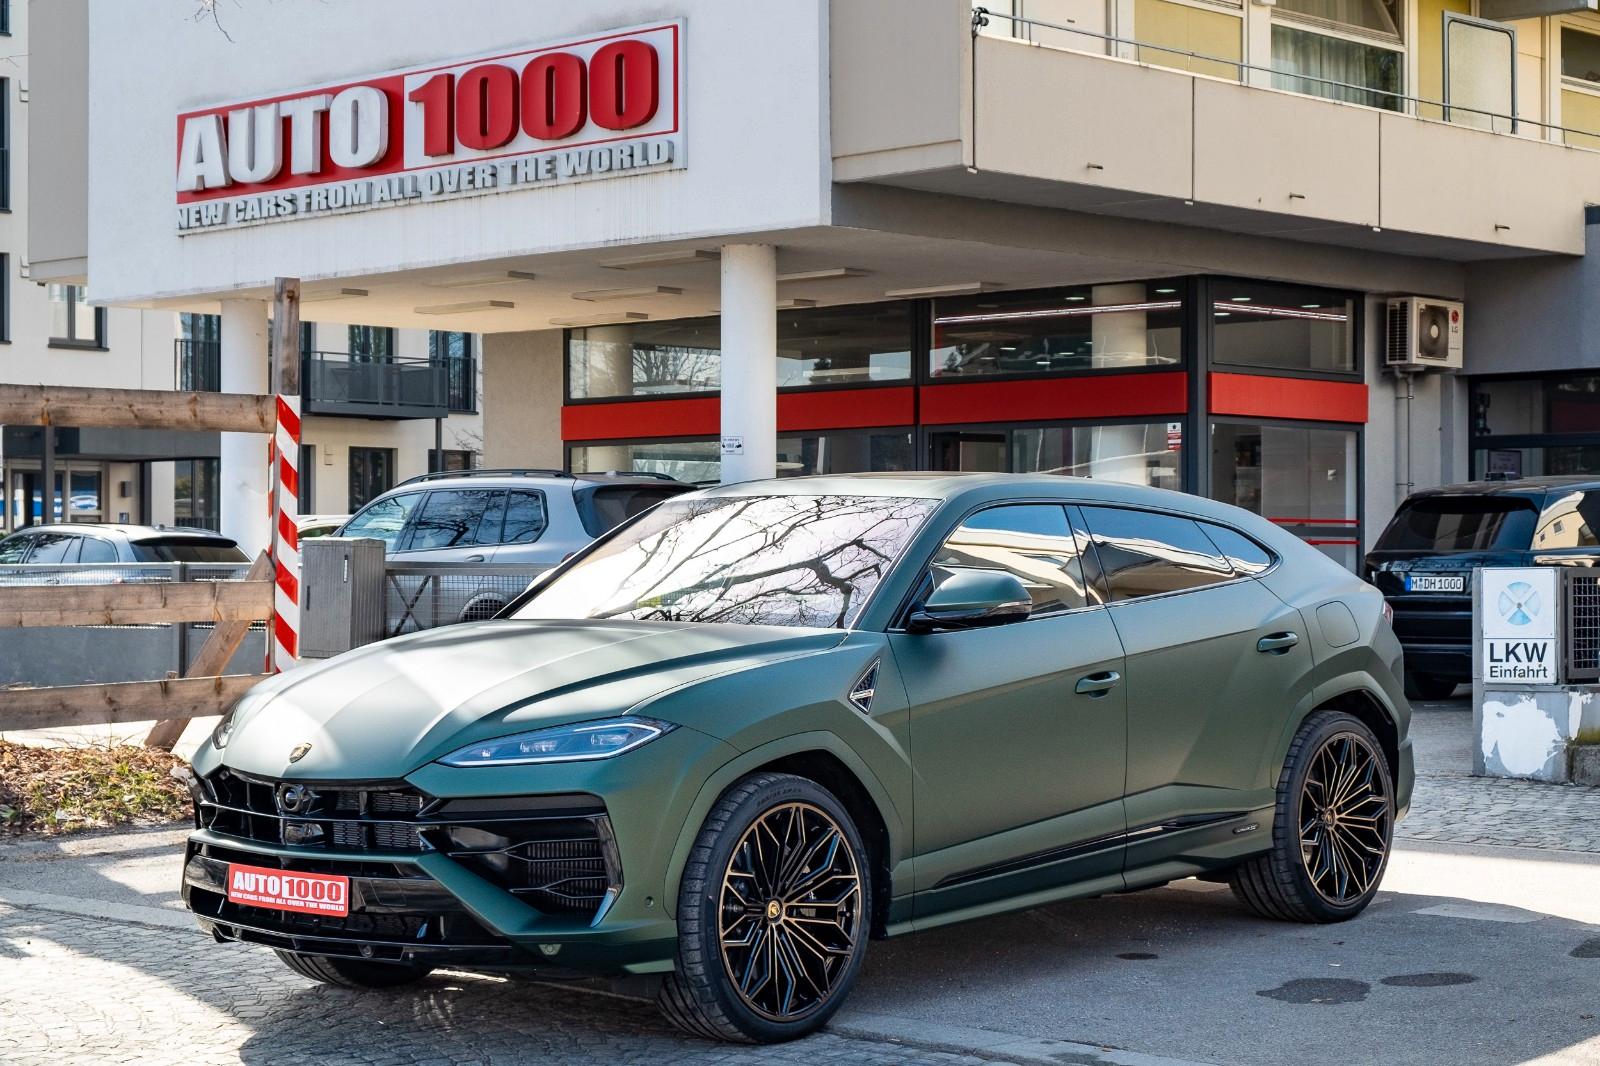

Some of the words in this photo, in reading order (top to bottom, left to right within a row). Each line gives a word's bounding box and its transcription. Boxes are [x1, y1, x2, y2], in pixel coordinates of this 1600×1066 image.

[176, 85, 389, 193] AUTO
[408, 39, 659, 158] 1000
[177, 202, 229, 230] NEW
[233, 192, 298, 222] CARS
[299, 181, 373, 211] FROM
[372, 174, 421, 201] ALL
[425, 164, 498, 196] OVER
[497, 155, 558, 185] THE
[557, 140, 675, 177] WORLD
[1439, 578, 1462, 590] 1000
[1489, 642, 1548, 663] LKW
[1489, 665, 1548, 678] Einfahrt
[233, 871, 280, 895] AUTO
[285, 879, 342, 902] 1000
[258, 895, 275, 904] FROM
[319, 903, 345, 912] WORLD
